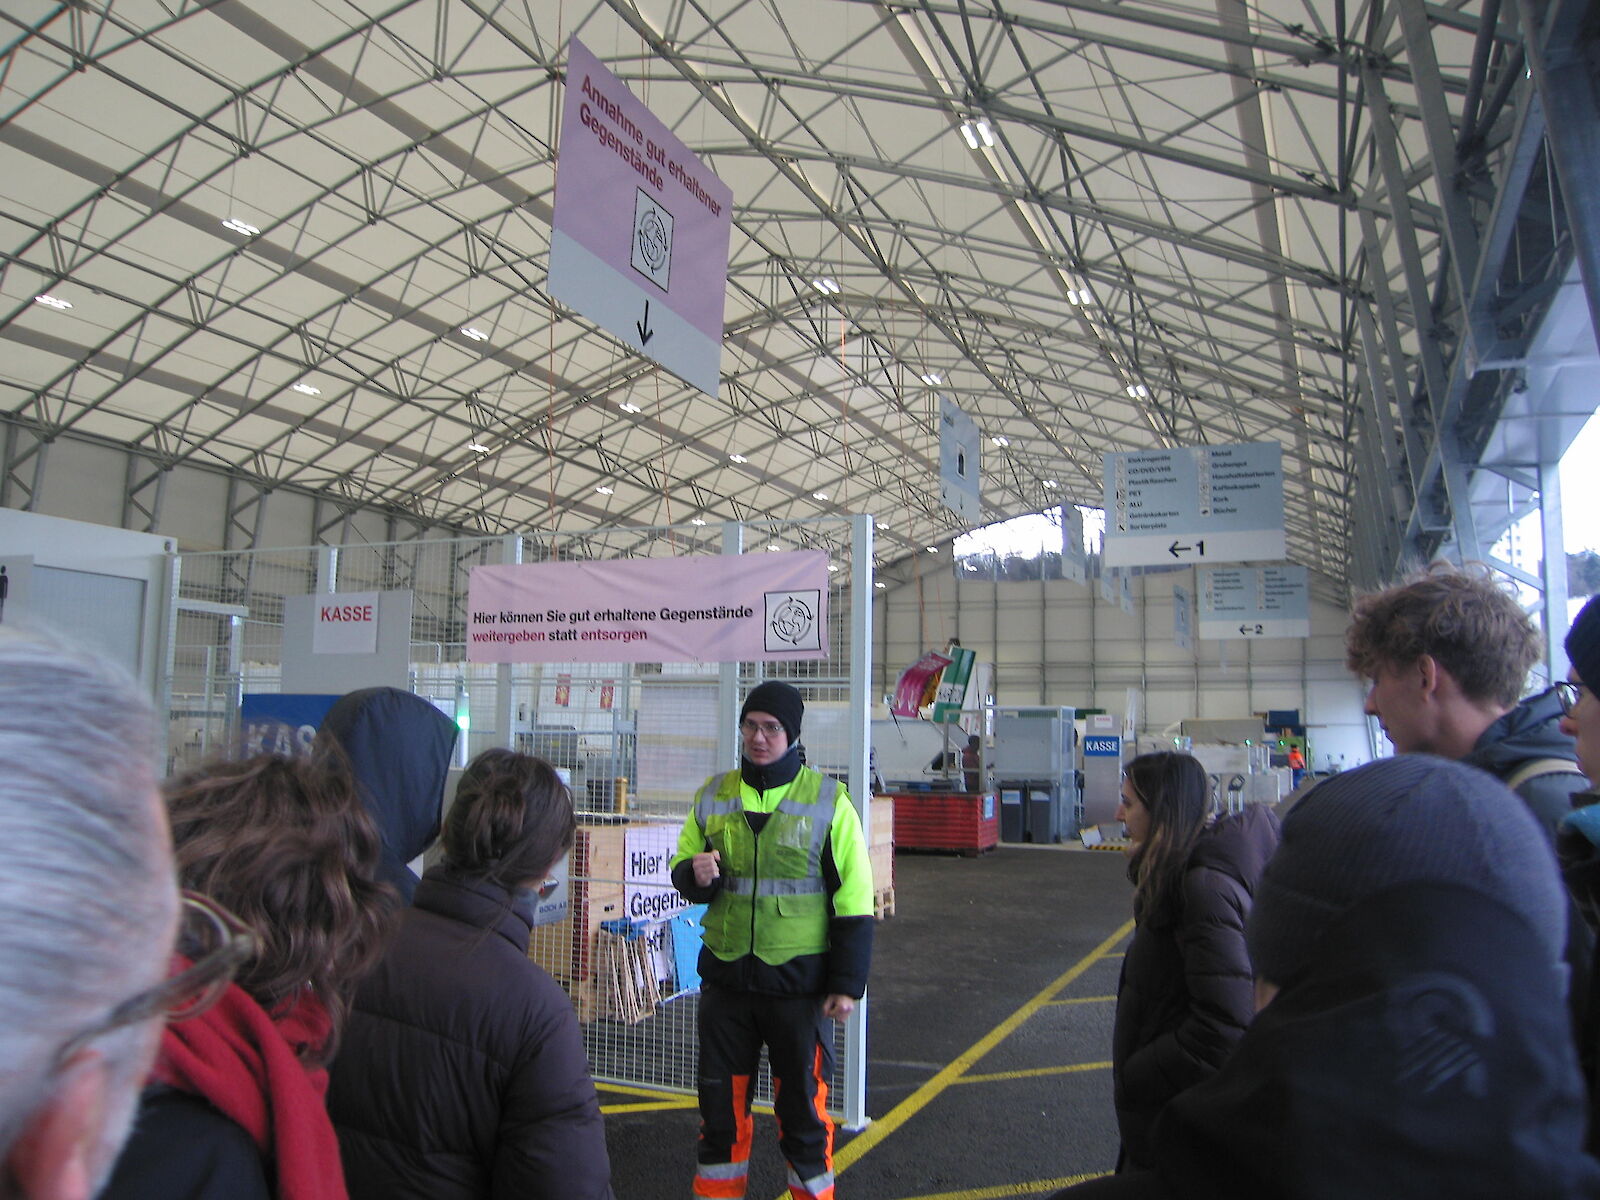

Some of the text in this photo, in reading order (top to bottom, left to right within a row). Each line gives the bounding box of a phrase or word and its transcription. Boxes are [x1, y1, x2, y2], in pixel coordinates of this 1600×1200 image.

[580, 102, 664, 192] Gegenstände
[581, 73, 722, 217] Annahme gut erhaltener
[1195, 539, 1205, 556] 1
[320, 605, 373, 622] KASSE
[473, 604, 753, 625] Hier können Sie gut erhaltene Gegenstände
[472, 628, 648, 644] weitergeben statt entsorgen
[1254, 623, 1264, 635] 2
[247, 723, 317, 759] KAS
[1085, 740, 1118, 752] KASSE
[631, 850, 663, 878] Hier
